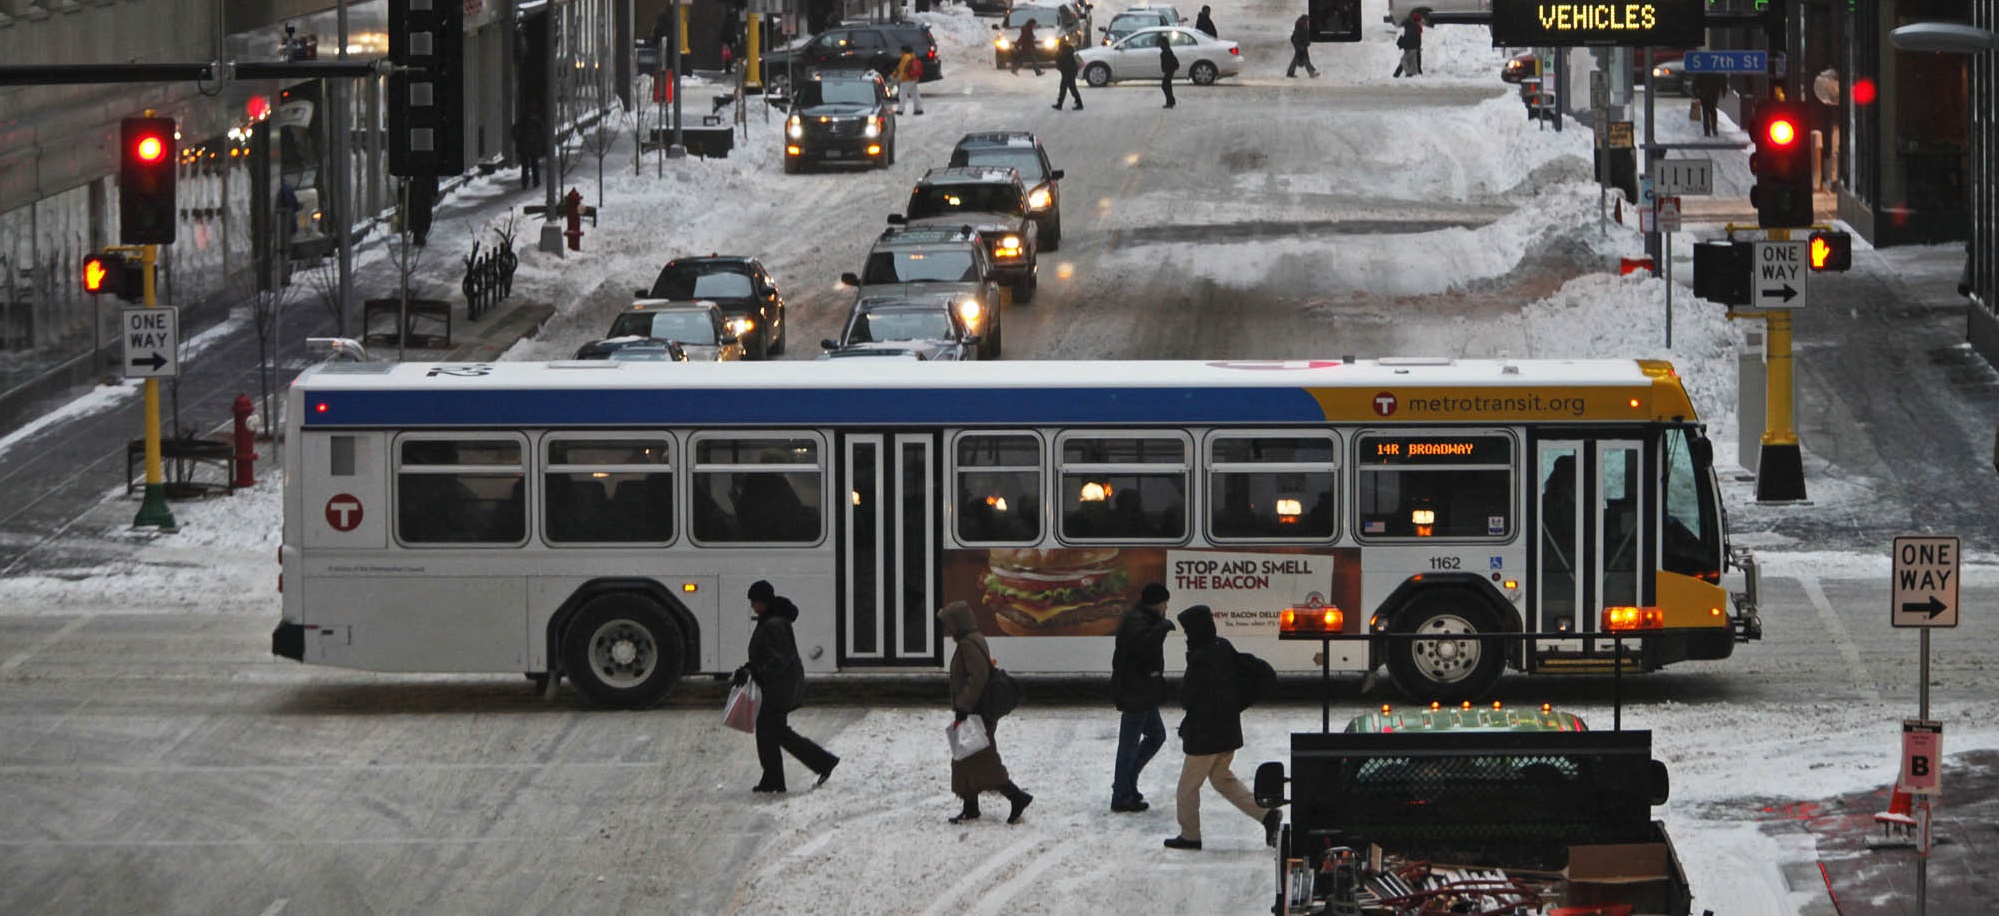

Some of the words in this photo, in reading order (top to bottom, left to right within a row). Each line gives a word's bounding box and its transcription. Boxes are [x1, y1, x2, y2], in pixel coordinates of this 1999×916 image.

[1538, 4, 1656, 30] VEHICLES
[1692, 54, 1702, 69] S
[1710, 54, 1735, 69] 7th
[1743, 54, 1760, 69] St
[1763, 245, 1799, 262] ONE
[1761, 264, 1800, 280] WAY
[131, 313, 167, 330] ONE
[130, 332, 168, 348] WAY
[1408, 393, 1586, 416] metrotransit.org
[1377, 443, 1400, 455] 14R
[1408, 443, 1474, 456] BROADWAY
[330, 502, 358, 528] T
[1902, 544, 1951, 565] ONE
[1175, 560, 1218, 575] STOP
[1221, 560, 1257, 575] AND
[1261, 560, 1313, 575] SMELL
[1429, 556, 1461, 570] 1162
[1175, 576, 1208, 590] THE
[1212, 575, 1270, 590] BACON
[1900, 569, 1951, 591] WAY
[1212, 611, 1229, 619] NEW
[1911, 755, 1930, 777] B
